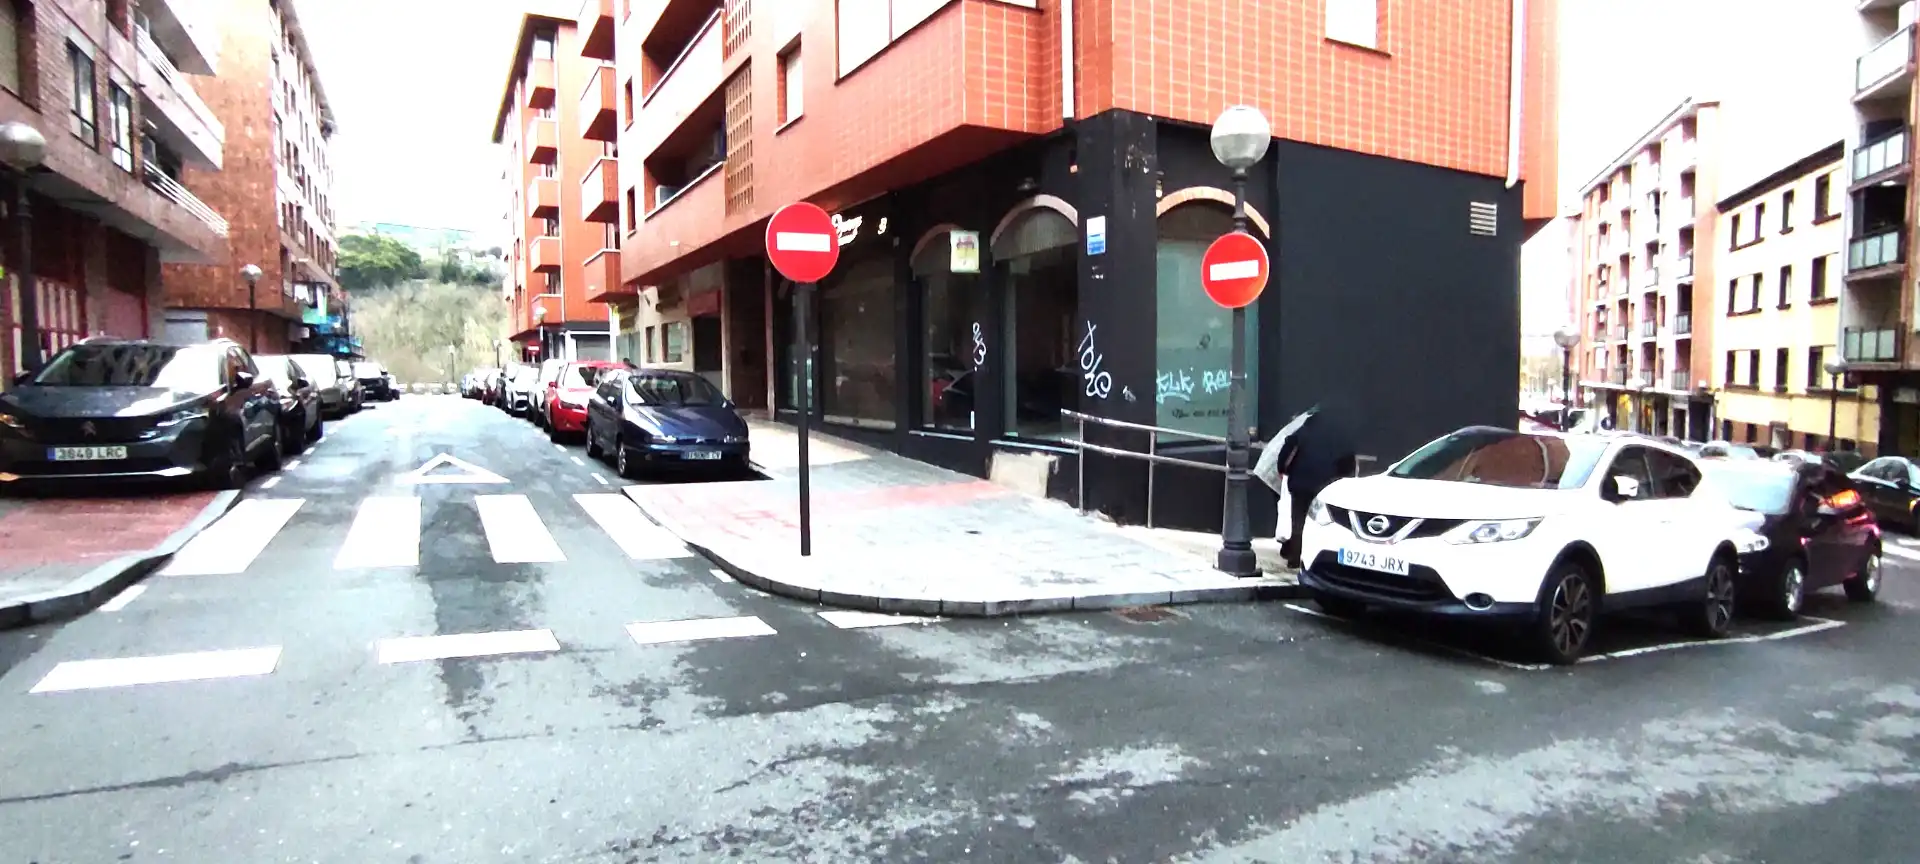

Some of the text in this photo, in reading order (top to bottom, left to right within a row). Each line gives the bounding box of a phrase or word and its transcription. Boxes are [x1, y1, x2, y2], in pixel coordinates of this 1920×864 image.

[98, 446, 125, 458] LRC
[1346, 550, 1403, 572] 9743 JRX
